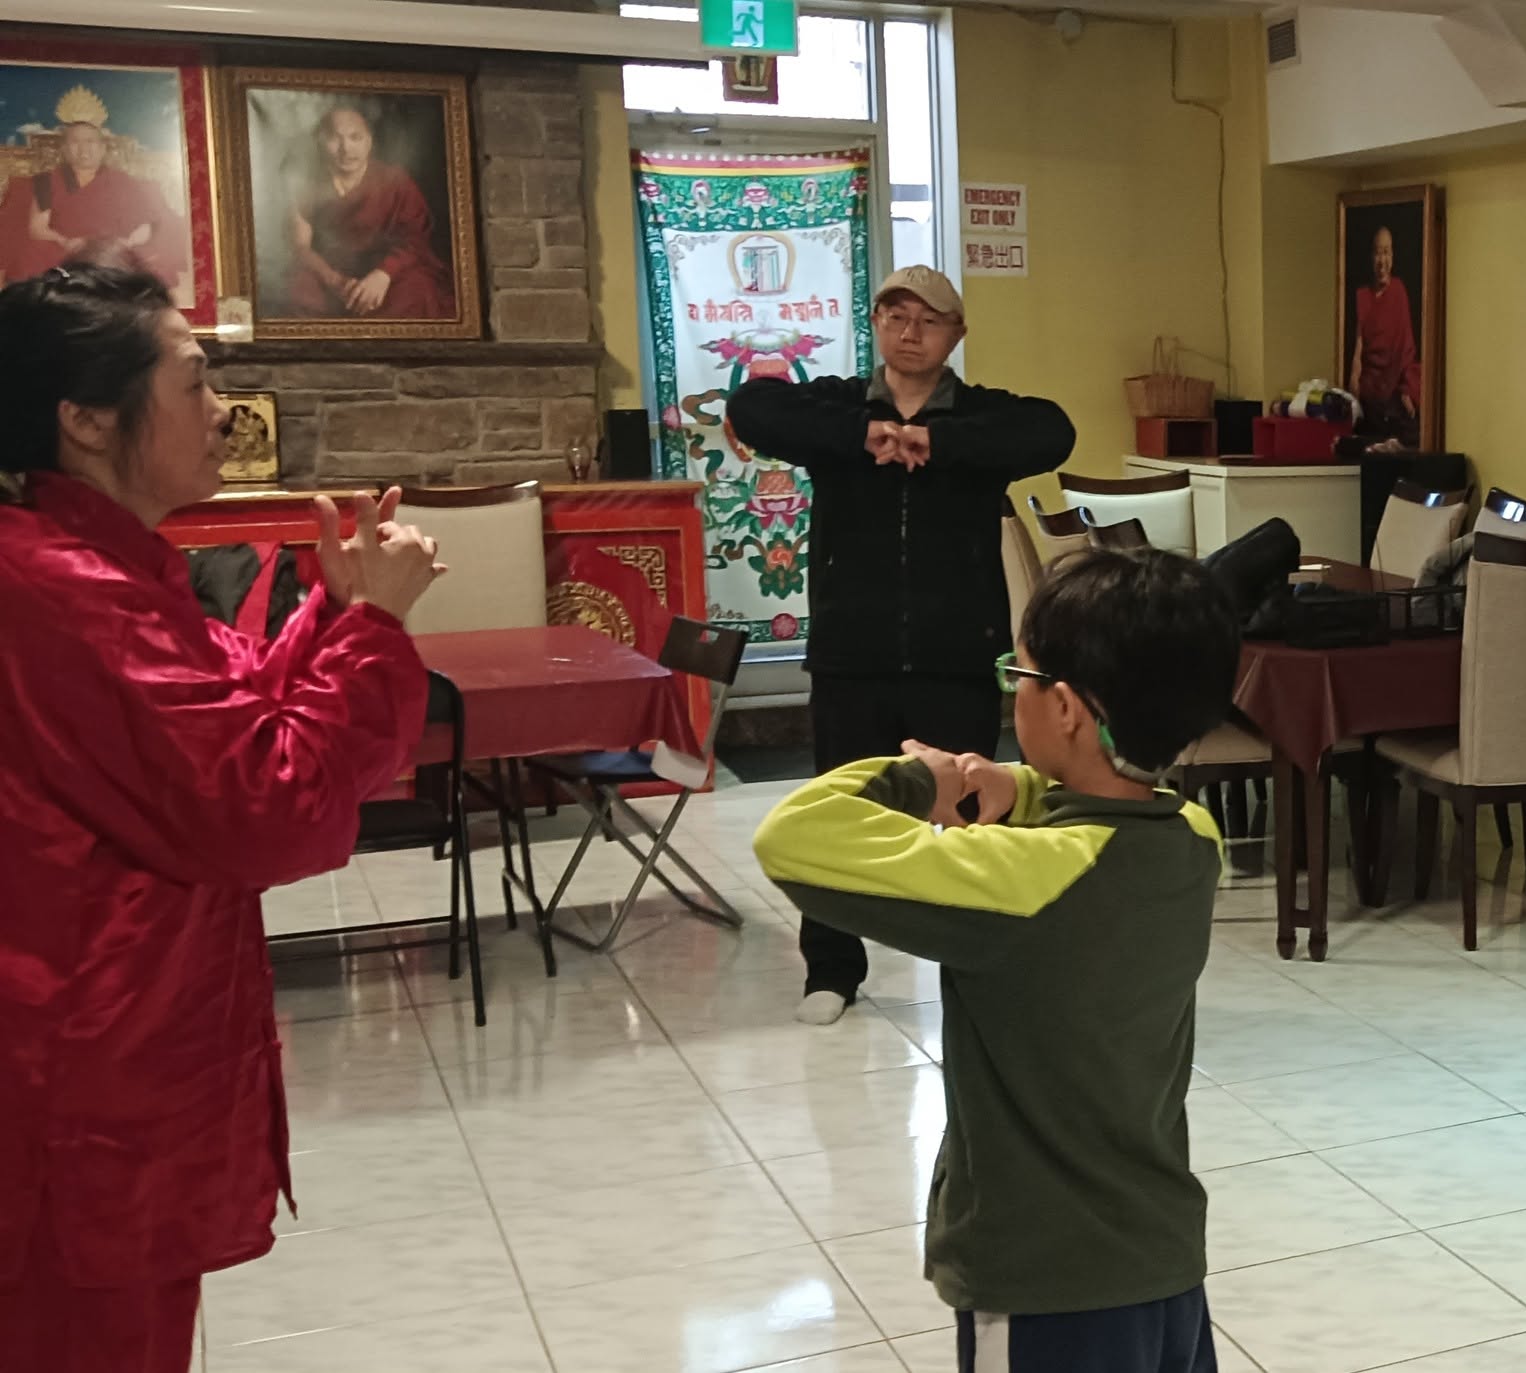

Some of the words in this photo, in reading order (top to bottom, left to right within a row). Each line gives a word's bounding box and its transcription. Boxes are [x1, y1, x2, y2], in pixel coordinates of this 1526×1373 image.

[964, 188, 1020, 207] EMERGENCY
[970, 208, 989, 225] EXIT
[992, 210, 1015, 226] ONLY
[966, 243, 1023, 269] 緊急出口
